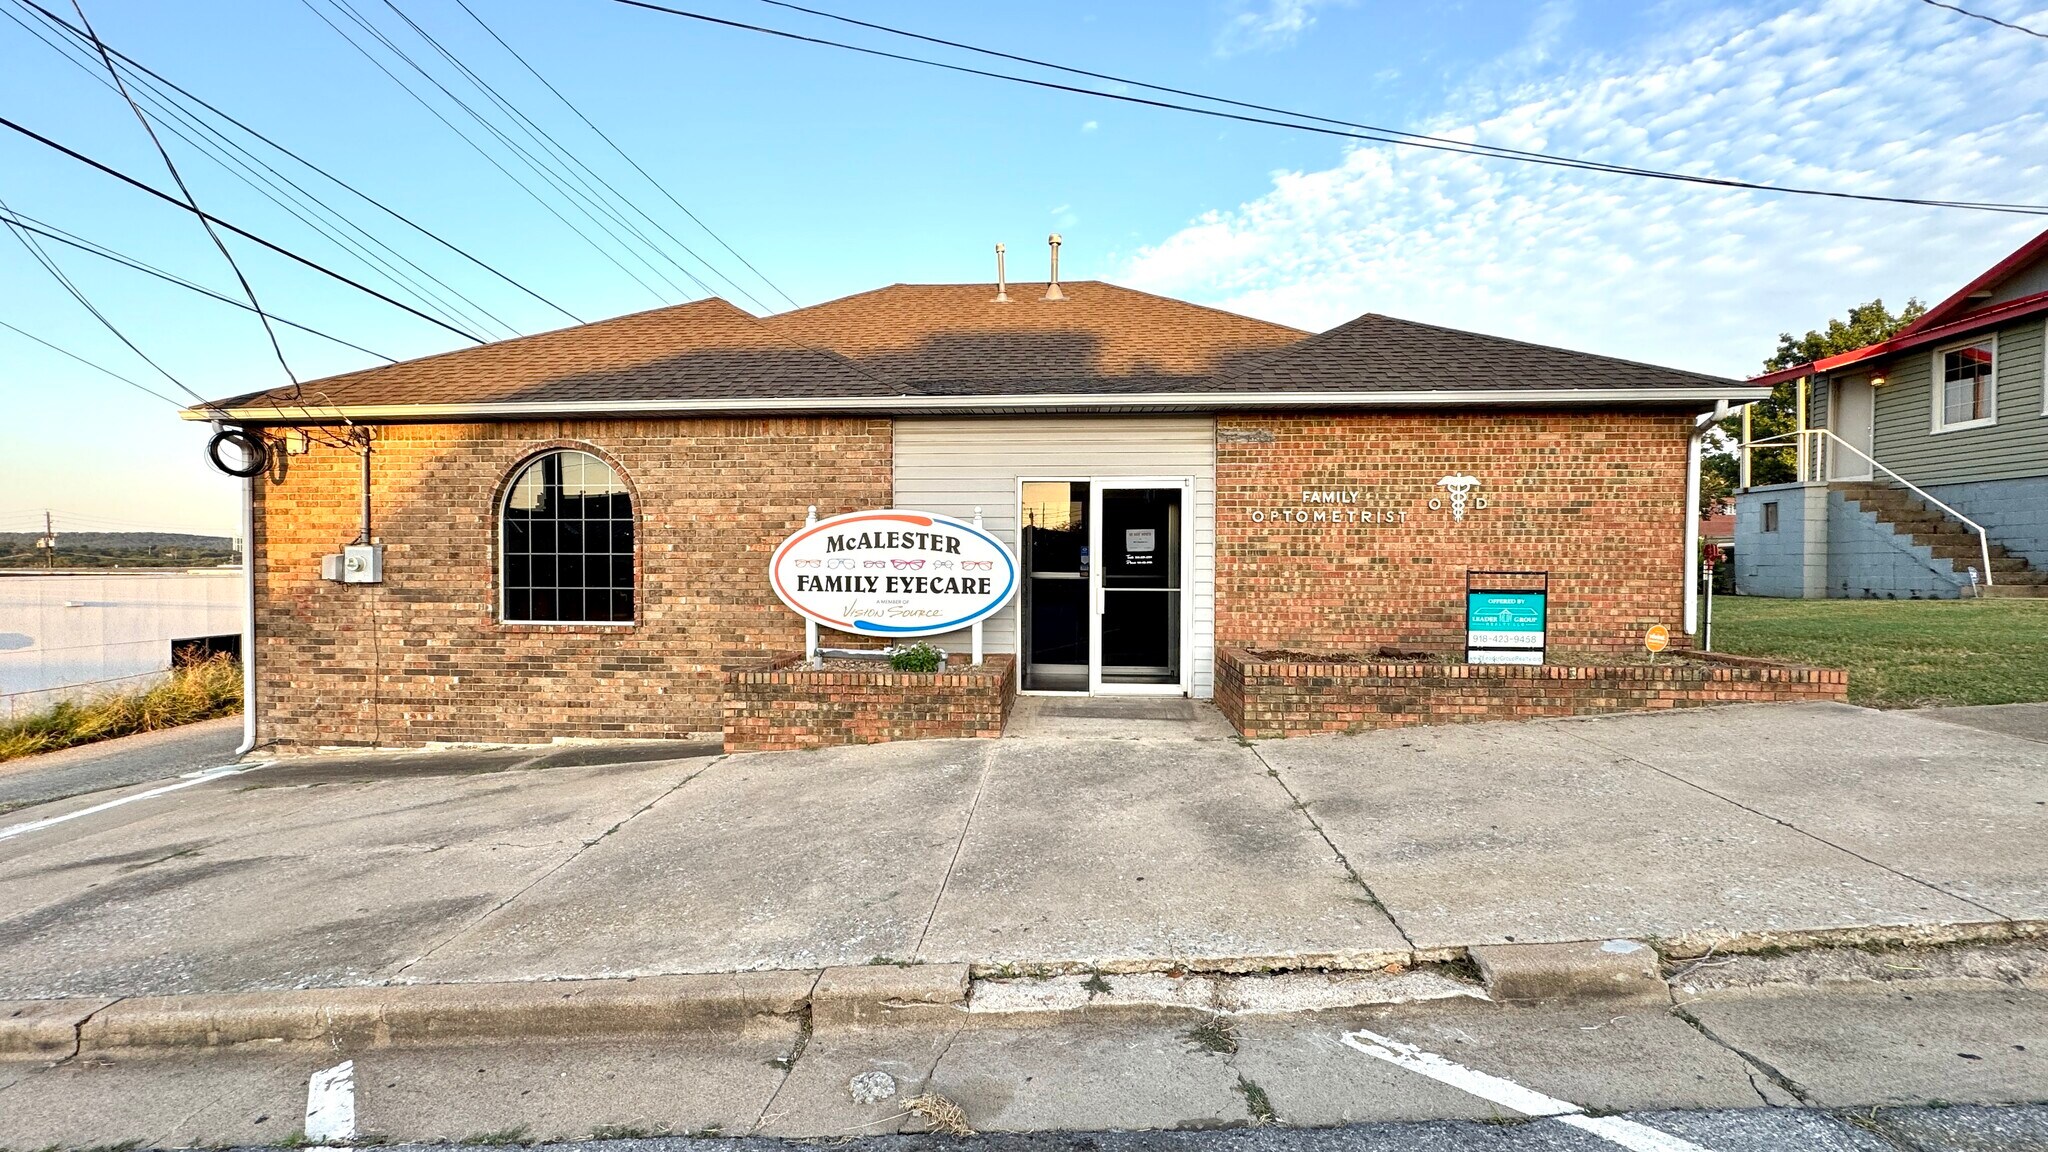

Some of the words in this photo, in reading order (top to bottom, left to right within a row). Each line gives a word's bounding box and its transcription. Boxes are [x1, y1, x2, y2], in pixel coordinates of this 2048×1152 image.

[1302, 490, 1359, 504] FAMILY
[1428, 498, 1442, 511] O
[1475, 497, 1488, 510] D
[1251, 510, 1408, 524] OPTOMETRIST
[826, 532, 961, 554] McALESTER
[797, 575, 879, 593] FAMILY
[886, 576, 991, 594] EYECARE
[1472, 634, 1537, 643] 918-423-9458
